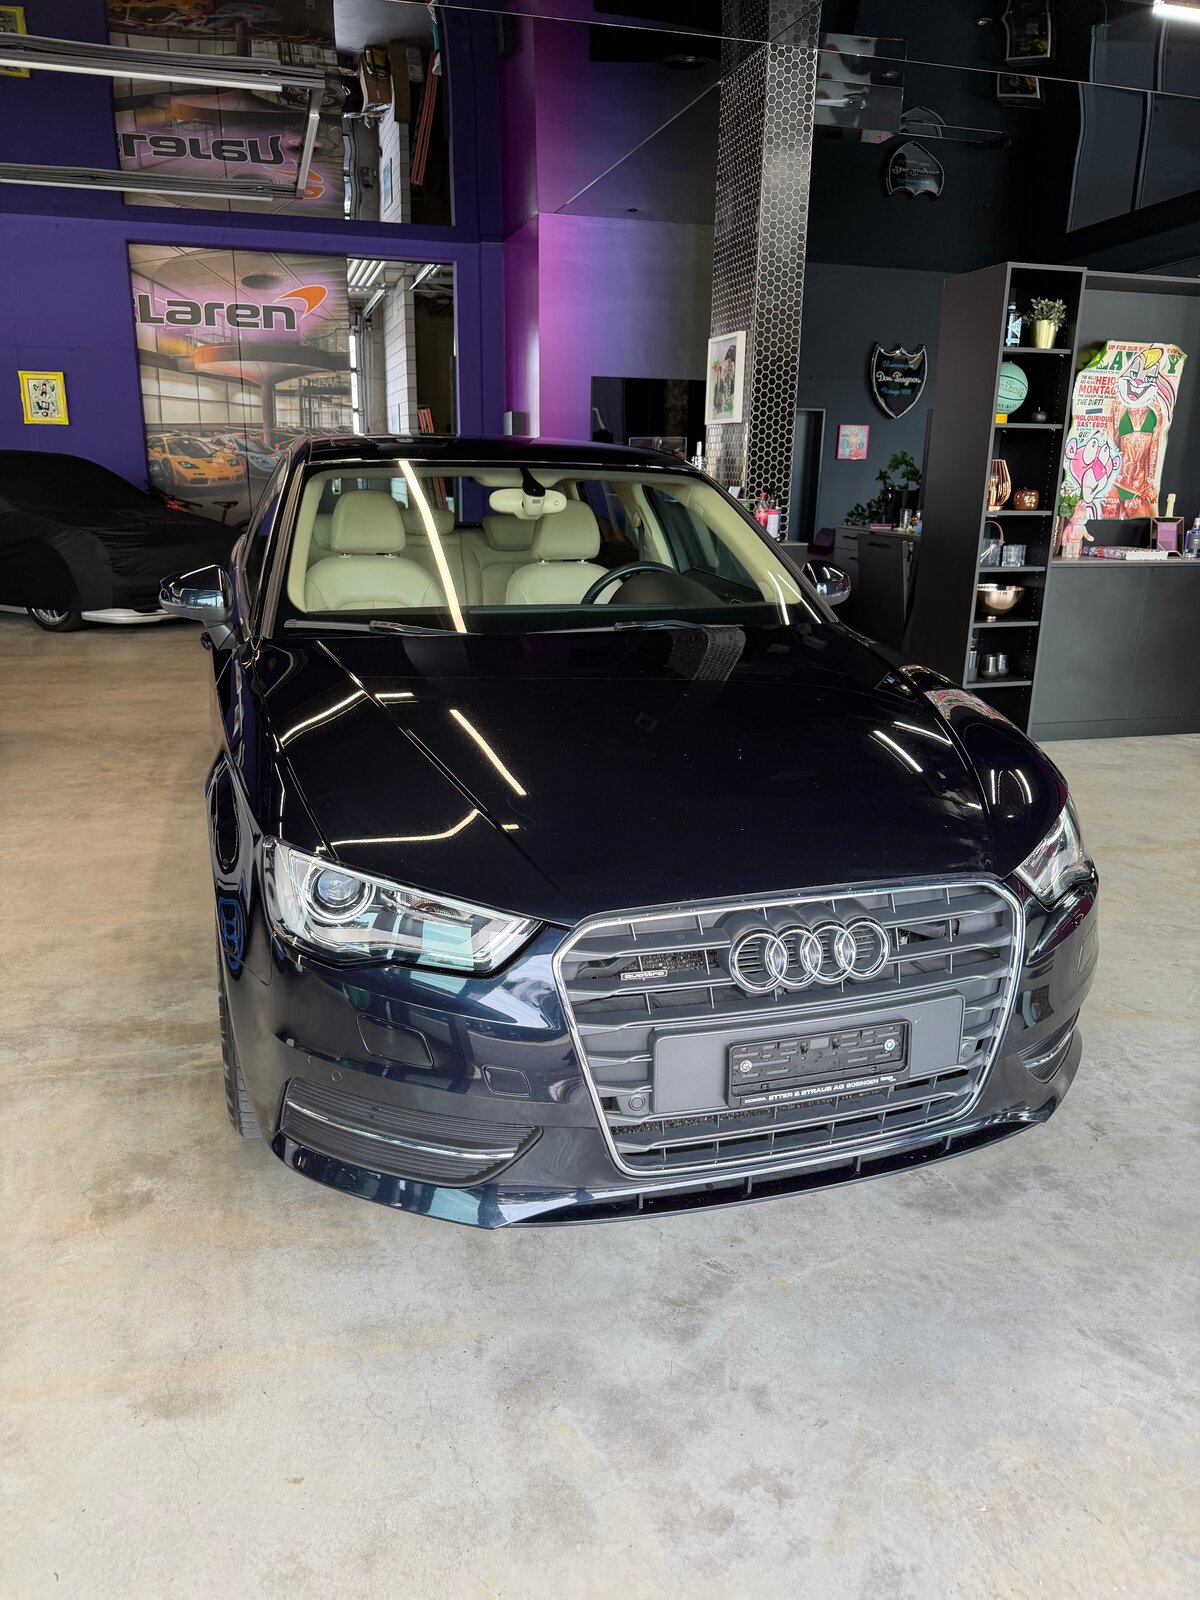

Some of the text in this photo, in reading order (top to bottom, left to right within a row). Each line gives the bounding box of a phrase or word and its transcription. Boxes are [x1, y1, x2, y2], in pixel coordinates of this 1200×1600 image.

[134, 293, 297, 331] Laren
[876, 371, 893, 382] Dom
[768, 1092, 793, 1101] ETTER
[801, 1086, 832, 1096] STRAUB
[833, 1083, 844, 1091] AG
